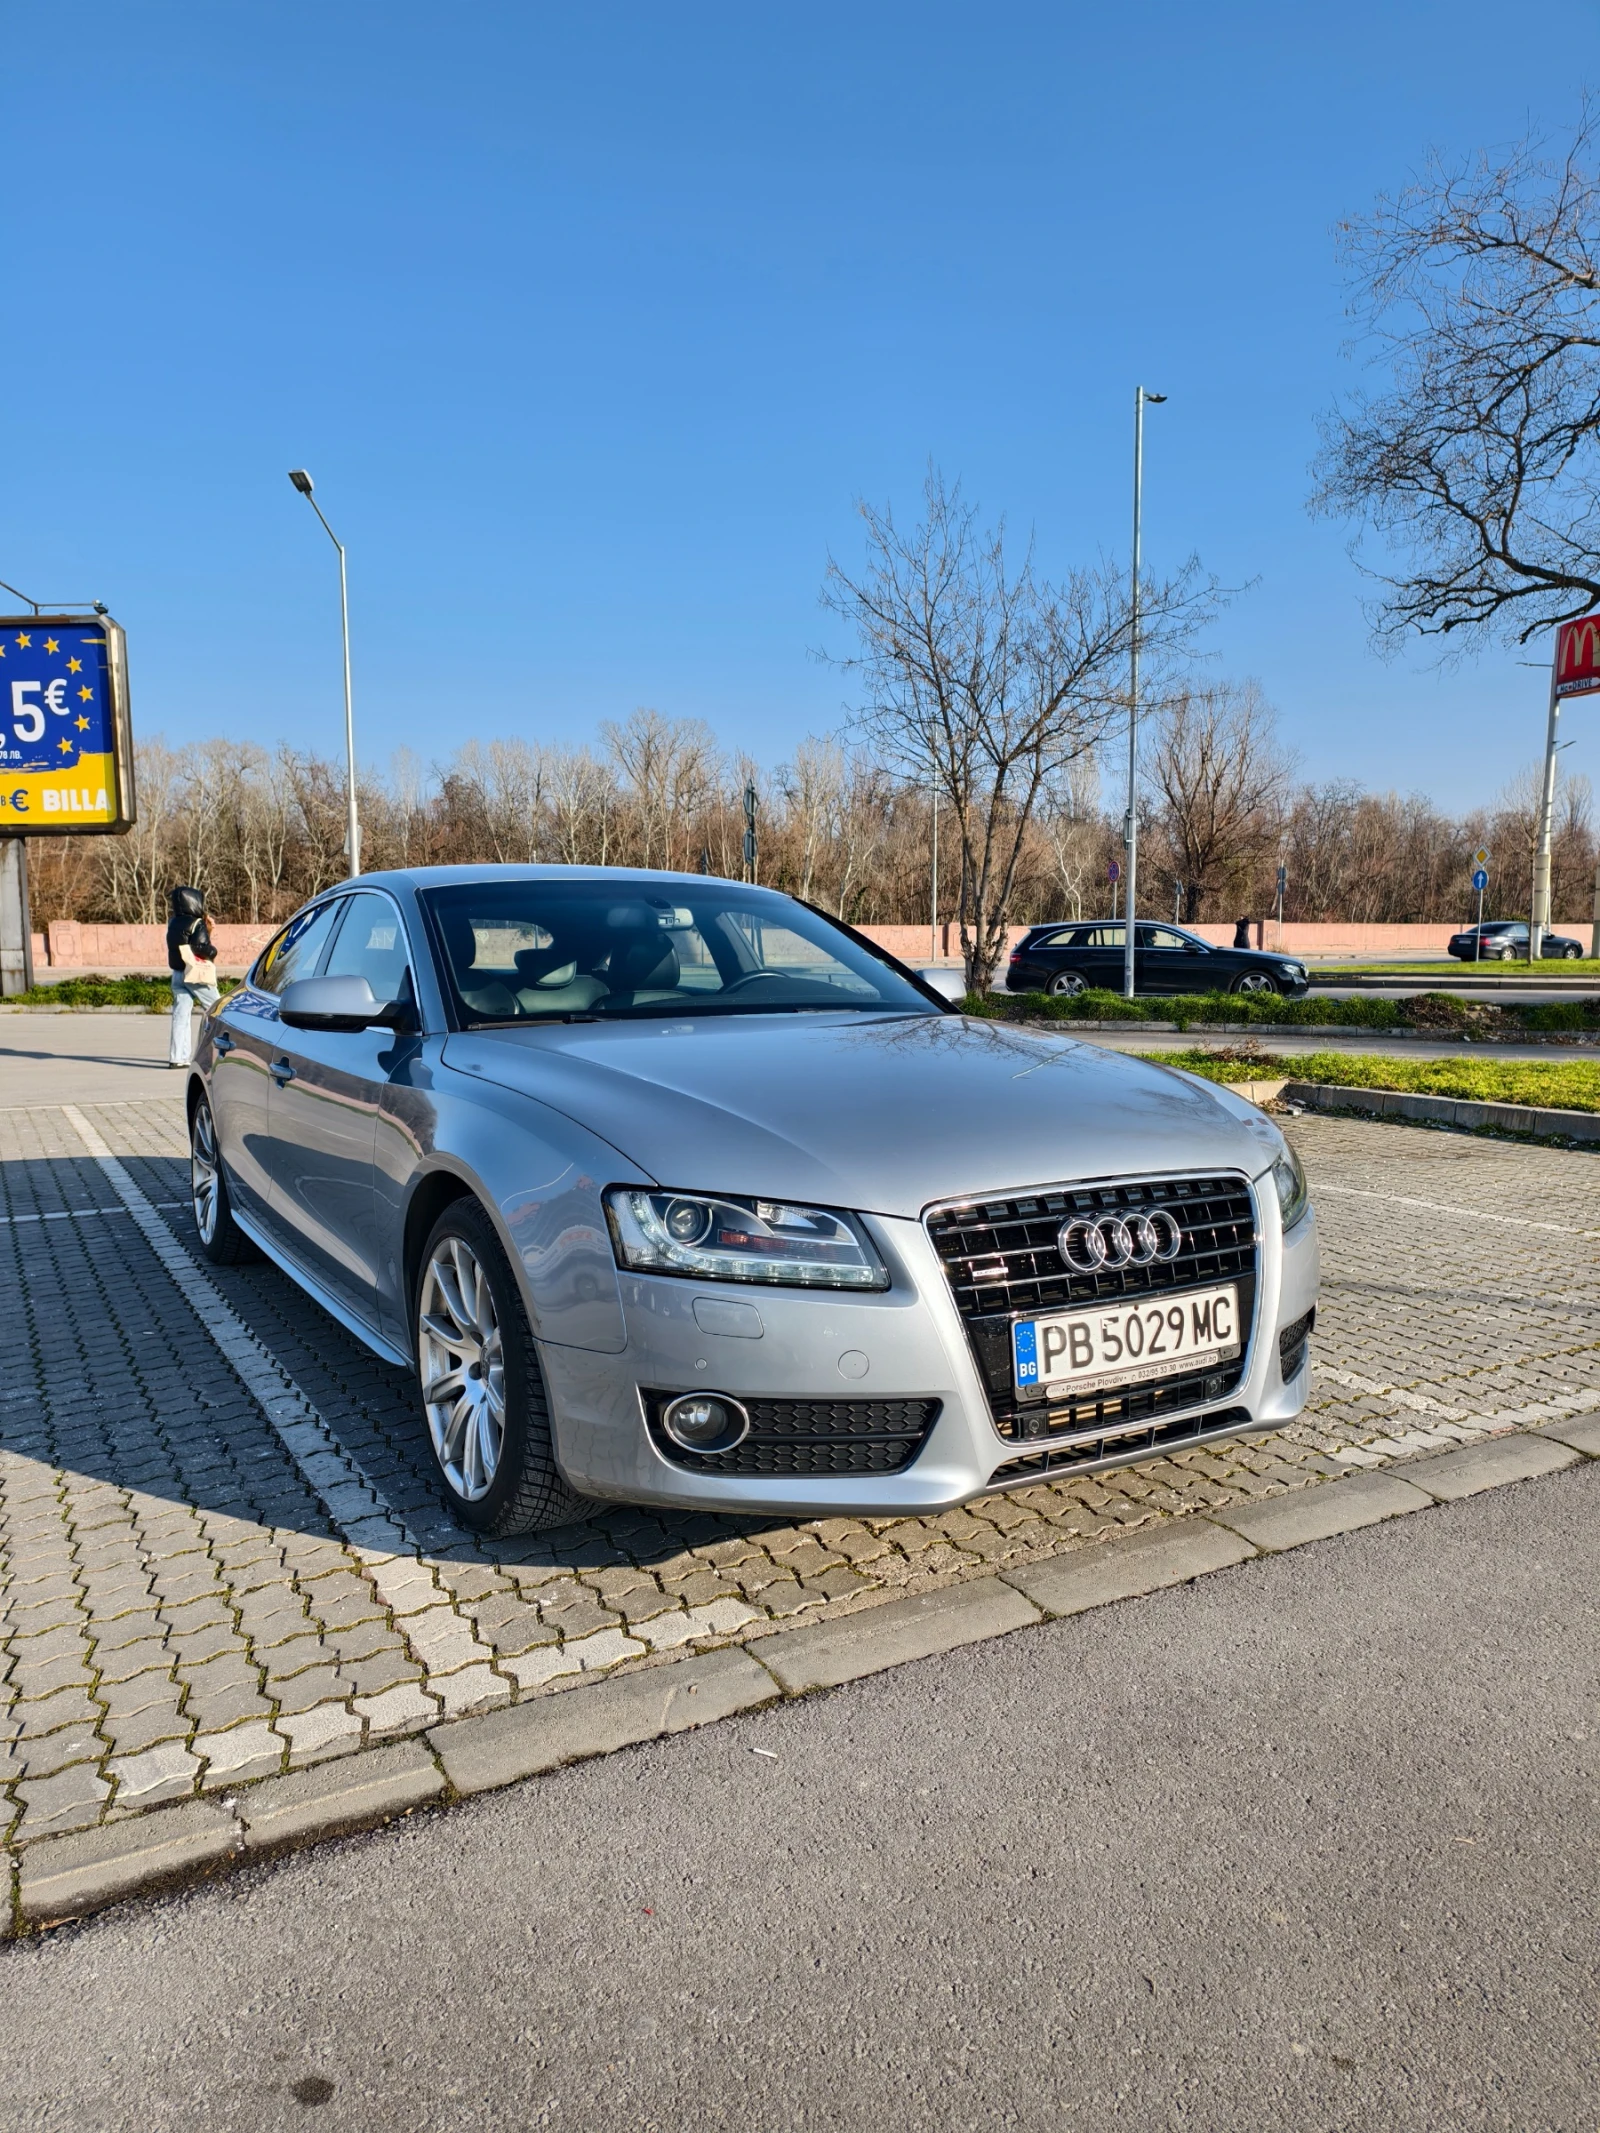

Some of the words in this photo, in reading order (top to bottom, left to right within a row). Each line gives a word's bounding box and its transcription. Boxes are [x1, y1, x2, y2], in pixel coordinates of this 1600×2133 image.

[9, 788, 30, 812] €
[42, 788, 112, 812] BILLA
[1042, 1321, 1094, 1375] PB
[1101, 1306, 1185, 1363] 5029
[1192, 1296, 1231, 1346] MC
[1019, 1361, 1037, 1378] BG
[1066, 1380, 1096, 1392] Porsche
[1097, 1375, 1124, 1387] Plovdiv
[1179, 1355, 1217, 1369] www.audi.bg
